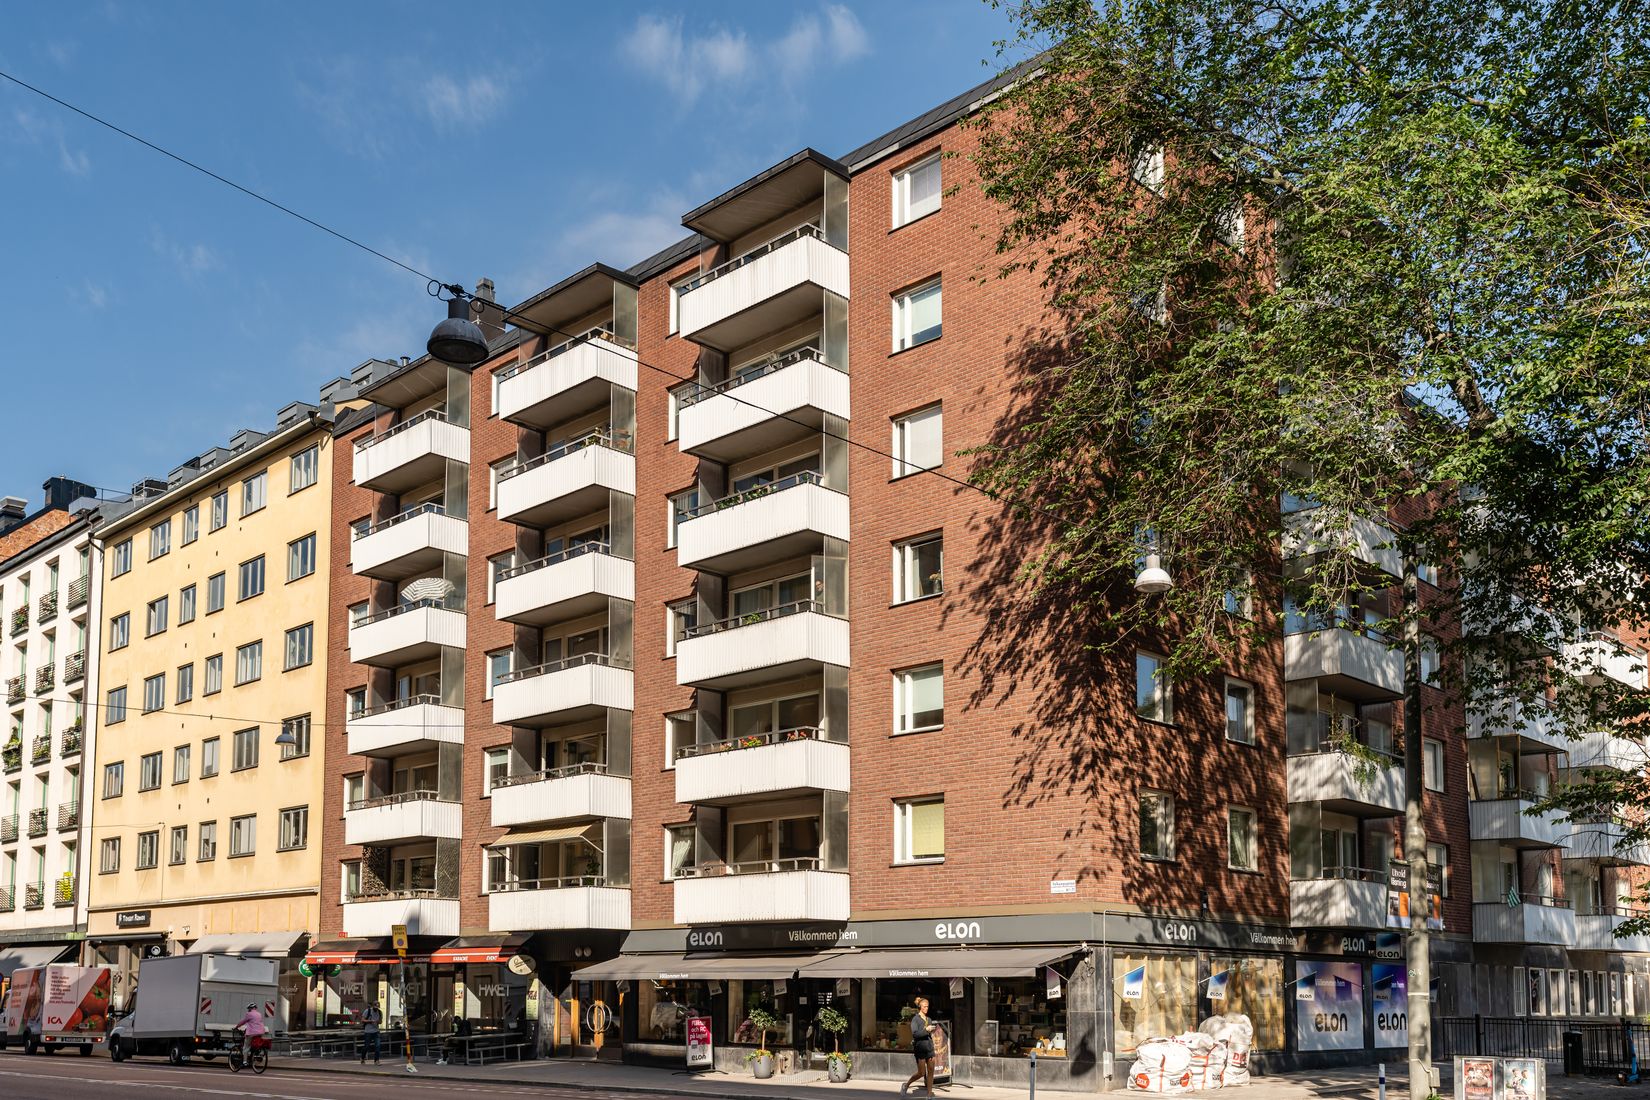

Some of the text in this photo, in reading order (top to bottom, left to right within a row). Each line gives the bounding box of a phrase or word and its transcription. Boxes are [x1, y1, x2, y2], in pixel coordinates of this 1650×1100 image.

[788, 930, 837, 942] Välkommen
[838, 928, 858, 940] hem
[1250, 932, 1285, 945] Välkommen
[1285, 934, 1298, 946] hem
[47, 1016, 63, 1025] ICA
